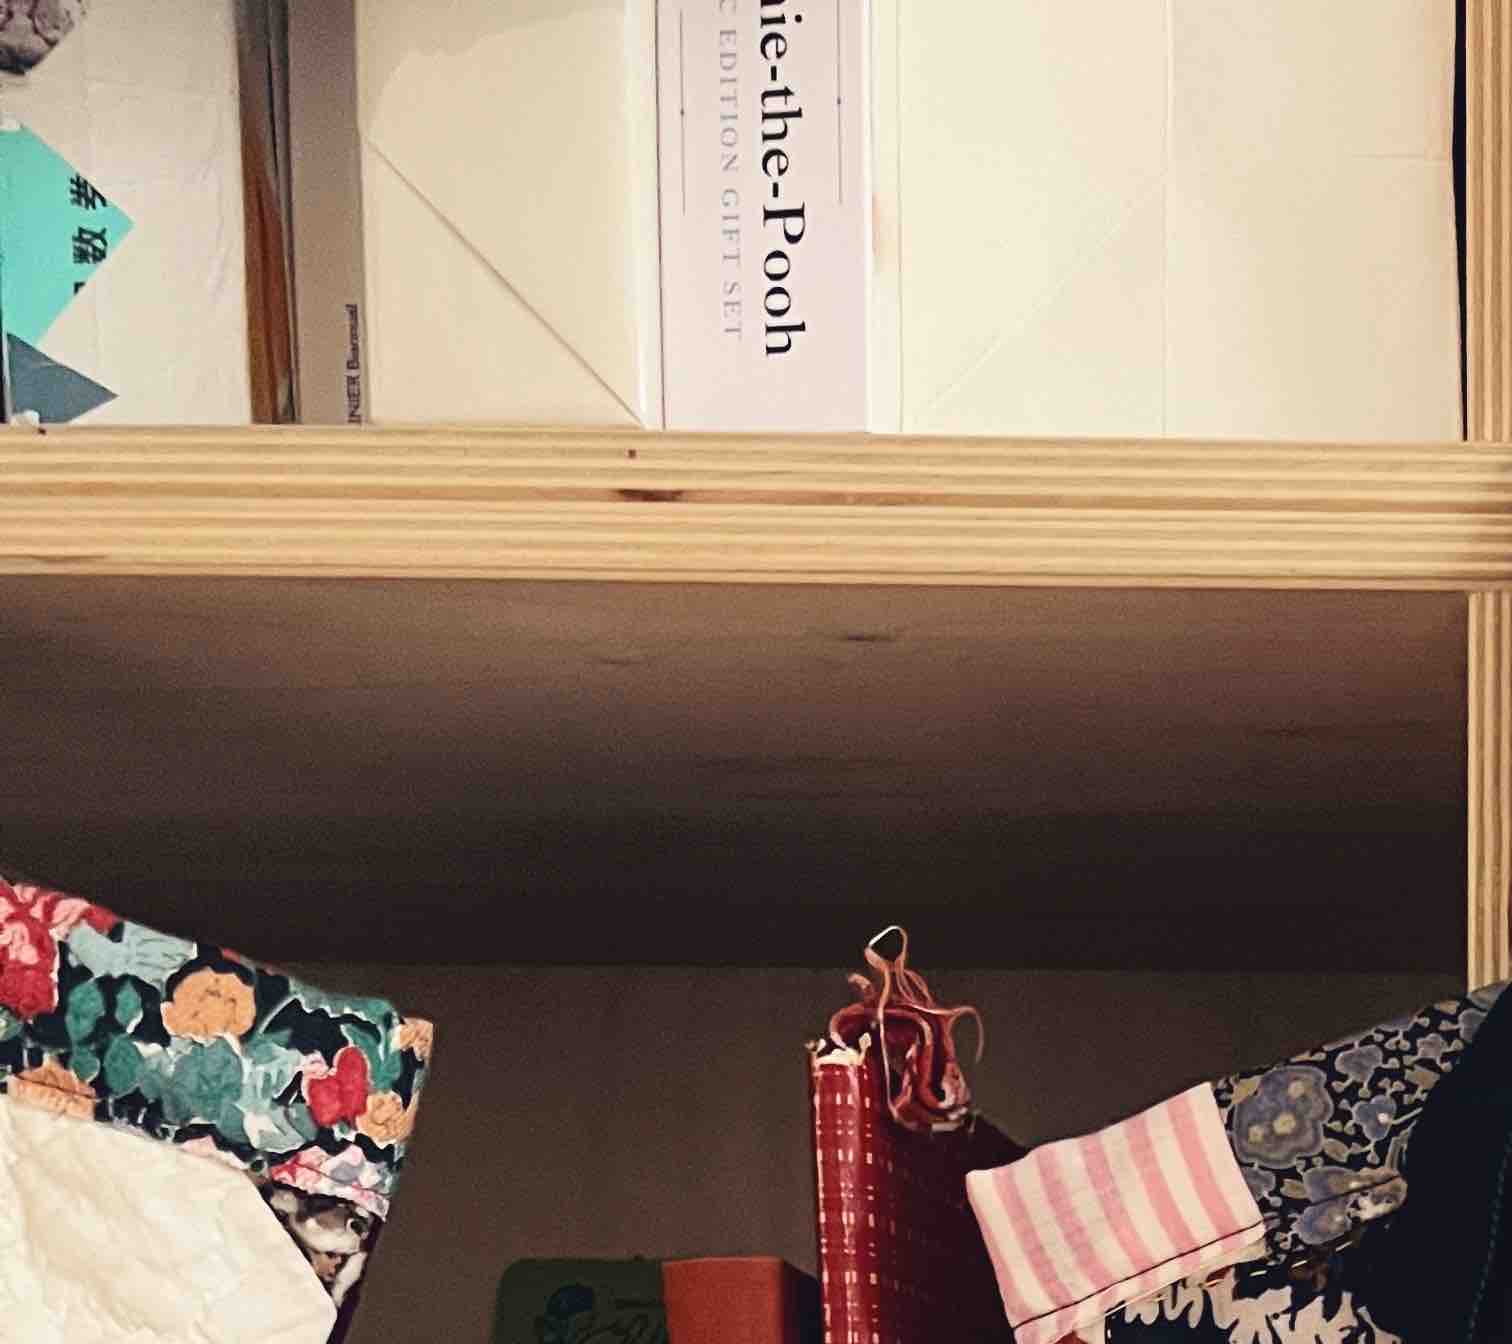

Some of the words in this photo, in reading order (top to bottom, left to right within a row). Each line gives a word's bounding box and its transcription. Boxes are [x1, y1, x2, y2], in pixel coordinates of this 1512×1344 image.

[719, 29, 739, 173] EDITION
[721, 188, 741, 270] GIFT
[723, 281, 743, 341] SET
